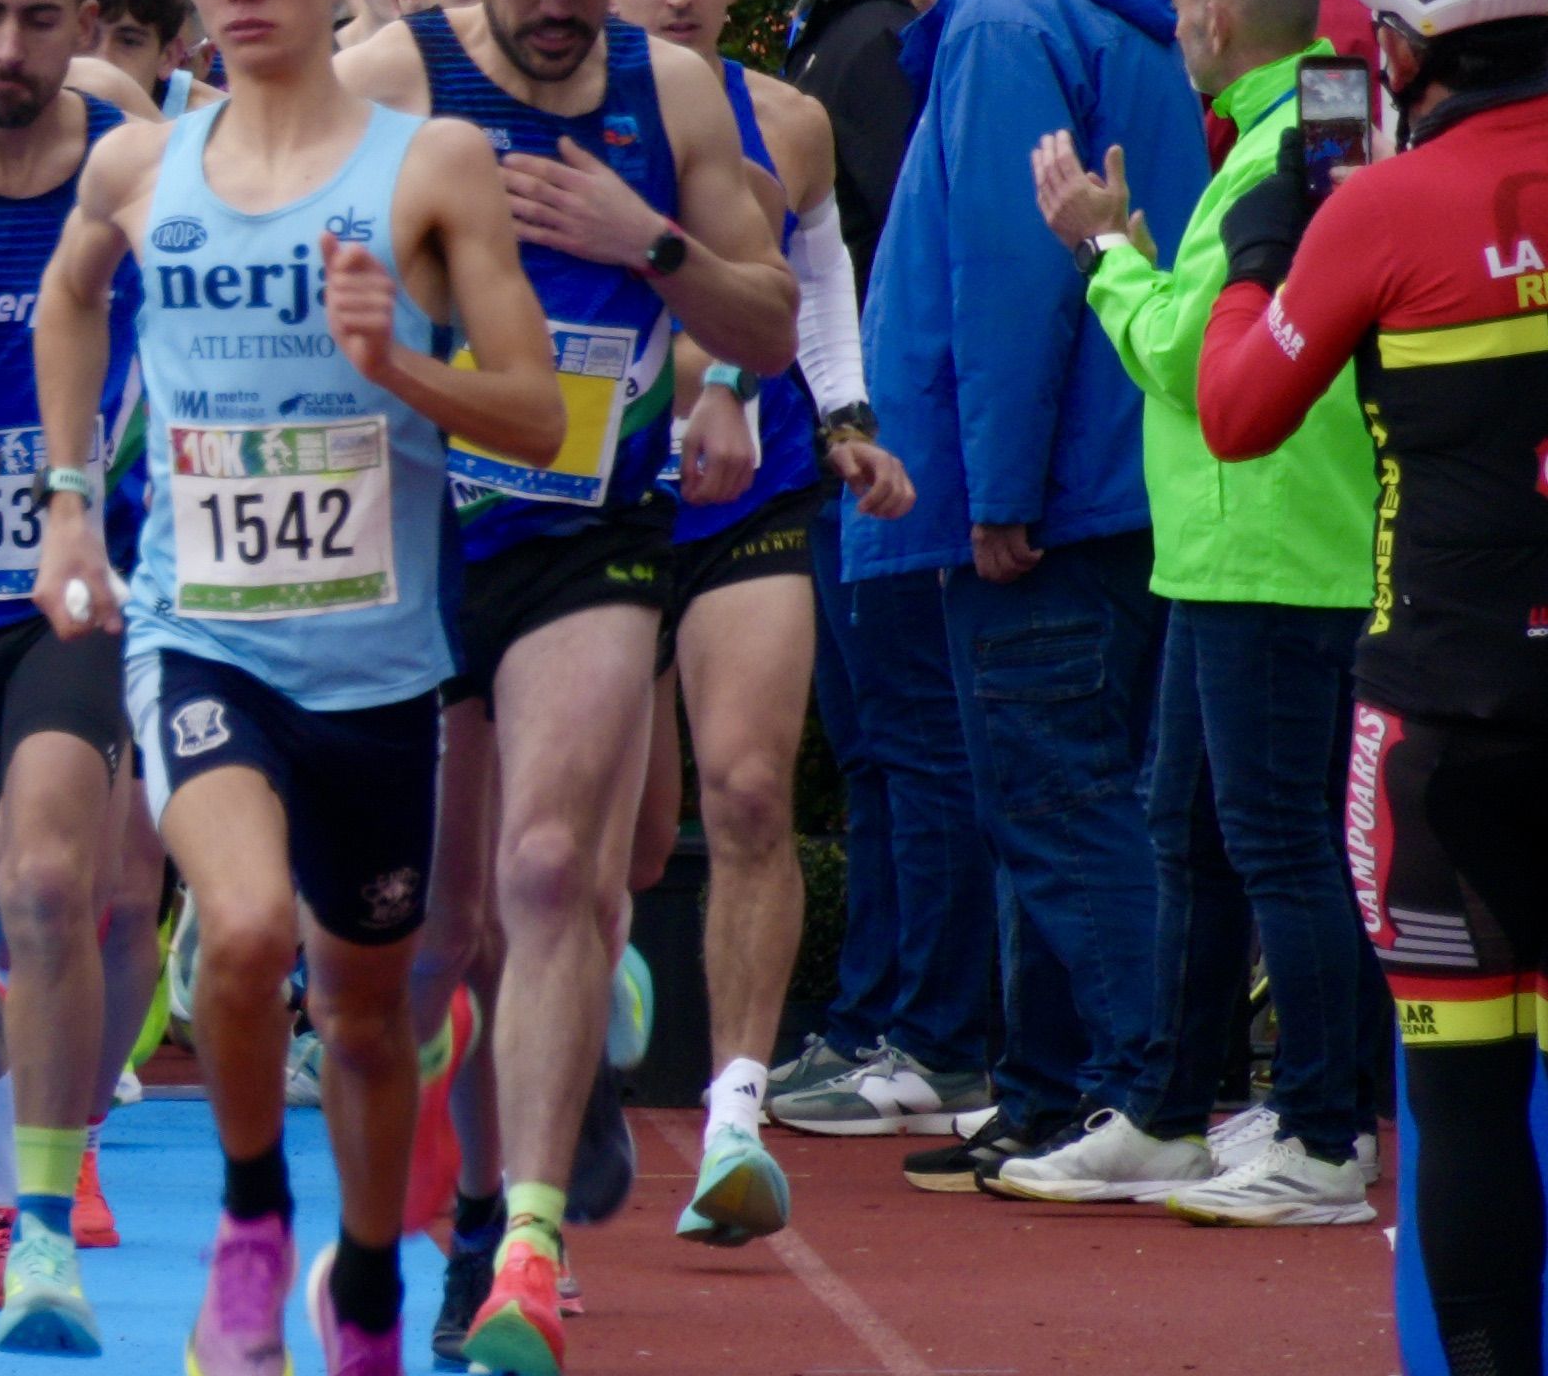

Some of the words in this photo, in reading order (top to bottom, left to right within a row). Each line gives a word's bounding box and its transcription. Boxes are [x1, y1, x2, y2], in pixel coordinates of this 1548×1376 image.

[1484, 239, 1546, 279] LA
[187, 334, 337, 361] ATLETISMO
[214, 389, 261, 404] metro
[183, 431, 245, 478] 10K
[199, 487, 355, 566] 1542
[1368, 458, 1402, 636] RELENGA
[1346, 706, 1386, 935] CAMPOARAS
